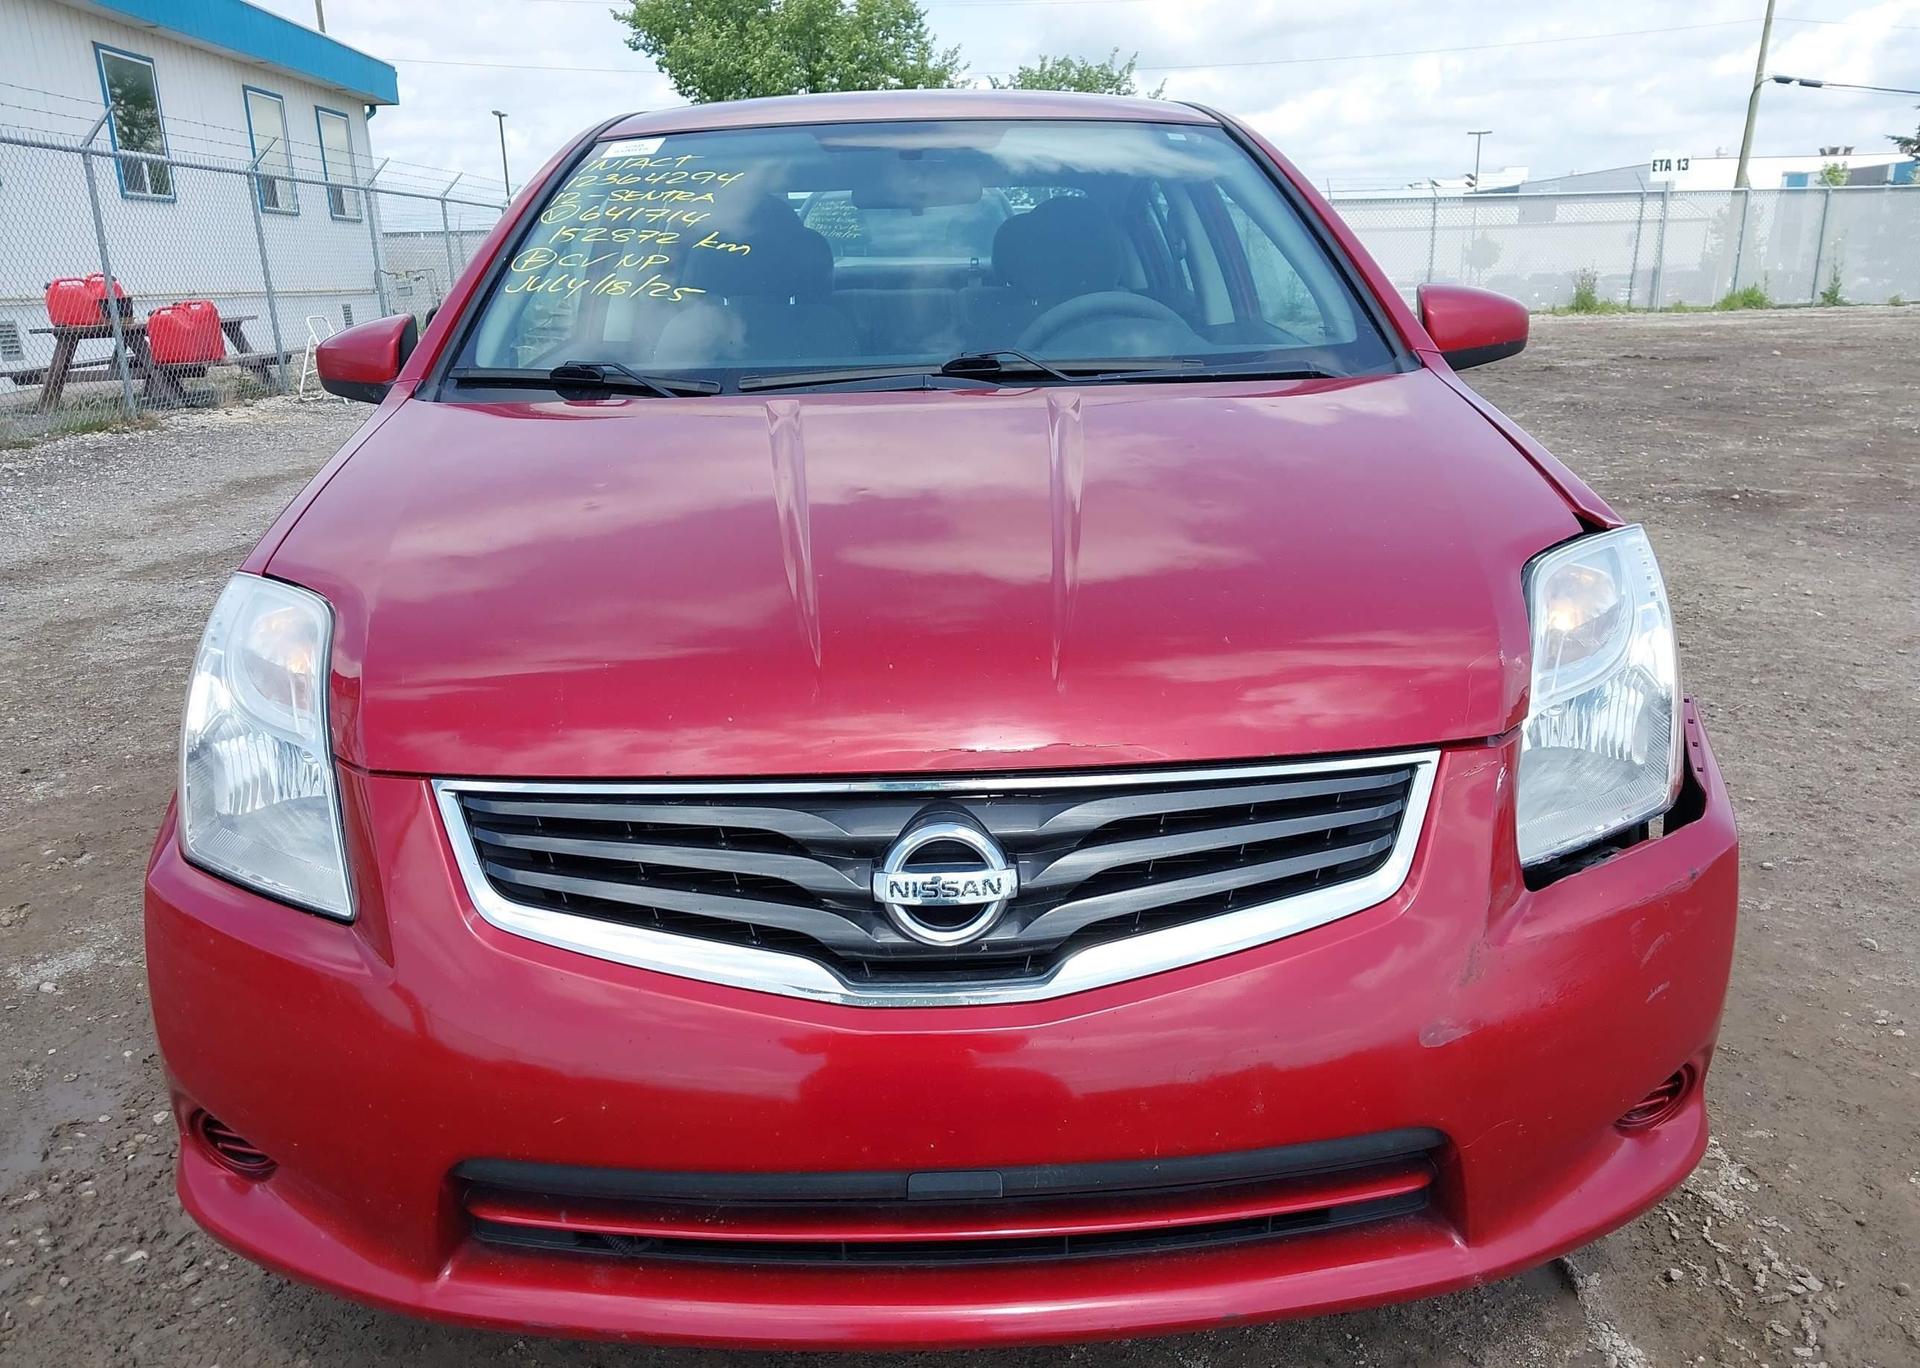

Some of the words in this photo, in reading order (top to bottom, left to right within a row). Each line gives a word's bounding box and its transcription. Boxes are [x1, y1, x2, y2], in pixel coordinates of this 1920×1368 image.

[580, 154, 705, 174] INTACT
[1652, 159, 1672, 172] ETA
[1676, 158, 1690, 171] 13
[563, 171, 744, 190] 12364294
[608, 189, 715, 204] SENTRA
[579, 205, 711, 228] 641714
[549, 225, 681, 244] 152872
[692, 231, 752, 256] km
[889, 877, 1002, 898] NISSAN
